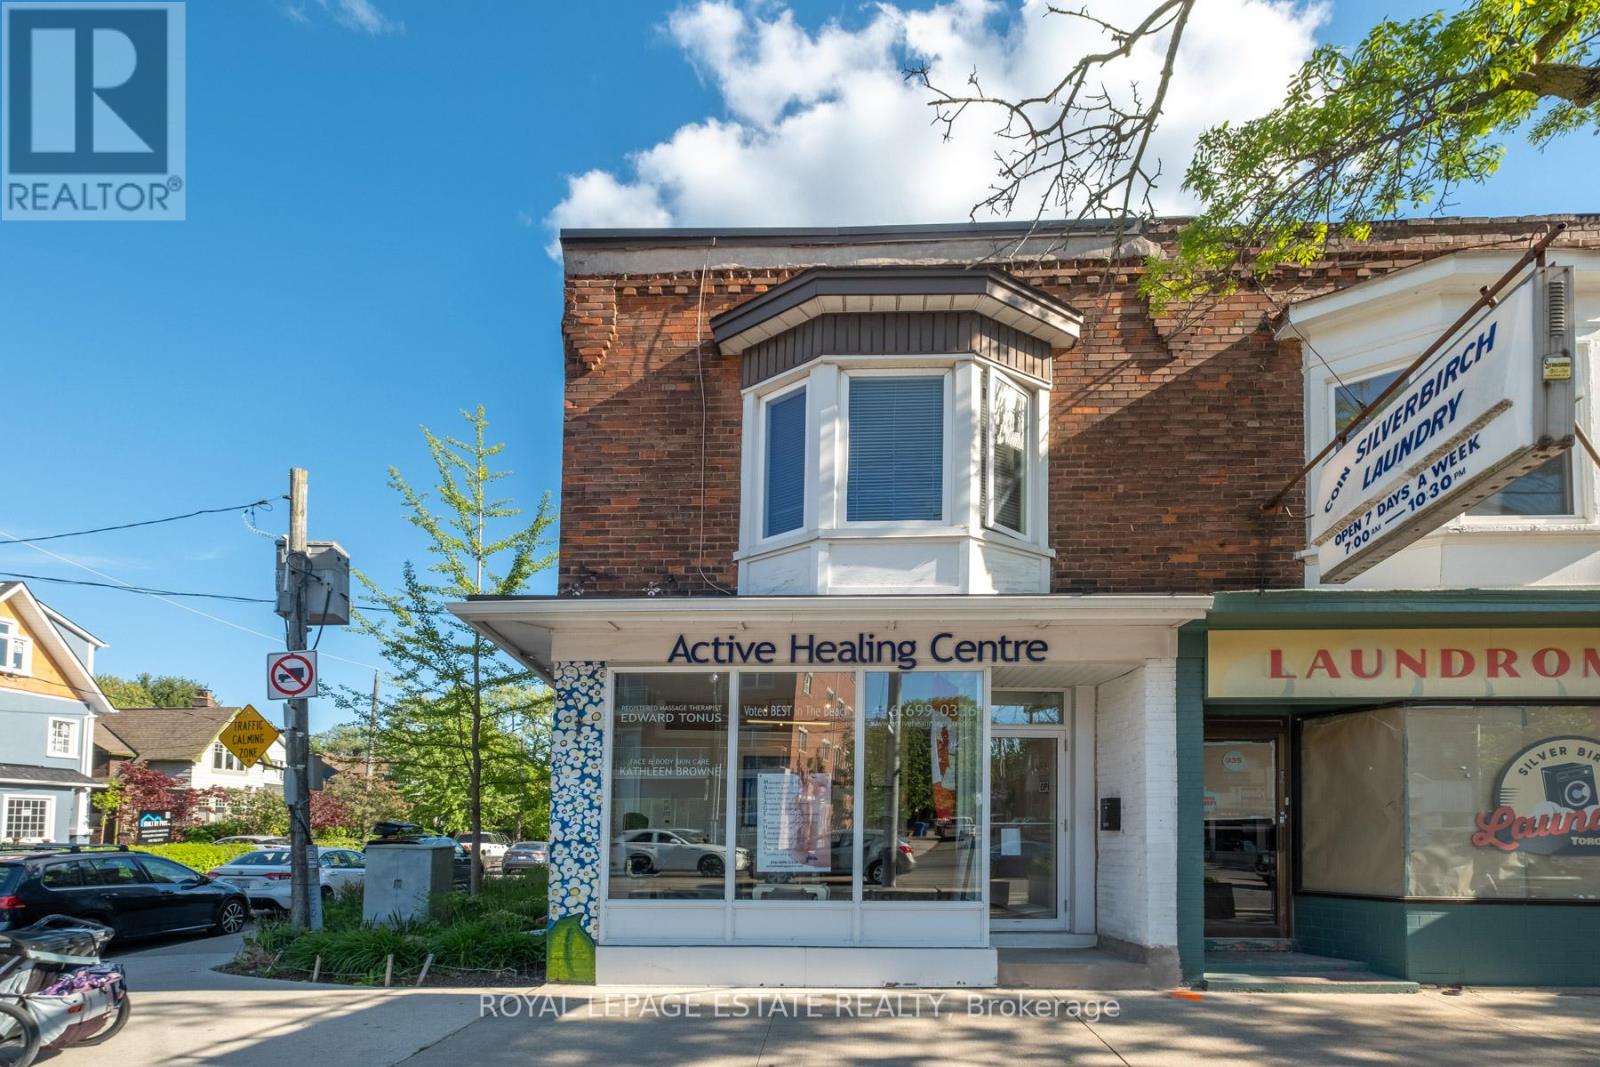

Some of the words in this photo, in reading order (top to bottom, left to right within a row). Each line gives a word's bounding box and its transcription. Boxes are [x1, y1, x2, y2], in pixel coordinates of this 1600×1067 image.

[1324, 466, 1351, 513] COIN
[1355, 321, 1498, 464] SILVERBIRCH
[1362, 389, 1465, 490] LAUNDRY
[1335, 519, 1362, 546] OPEN
[1365, 511, 1372, 526] 7
[1377, 484, 1410, 517] DAYS
[1417, 473, 1427, 490] A
[1431, 433, 1481, 478] WEEK
[1408, 474, 1452, 512] 10:30
[1453, 466, 1466, 480] PM
[667, 633, 776, 664] Active
[790, 633, 917, 670] Healing
[930, 632, 1048, 663] Centre
[620, 713, 675, 723] EDWARD
[678, 712, 722, 723] TONUS
[744, 705, 768, 717] Voted
[770, 705, 792, 717] BEST
[806, 705, 820, 717] The
[234, 720, 263, 731] TRAFFIC
[232, 734, 264, 745] CALMING
[239, 748, 257, 759] ZONE
[1518, 746, 1567, 776] SILVER
[620, 767, 672, 777] KATHLEEN
[676, 767, 721, 777] BROWNE
